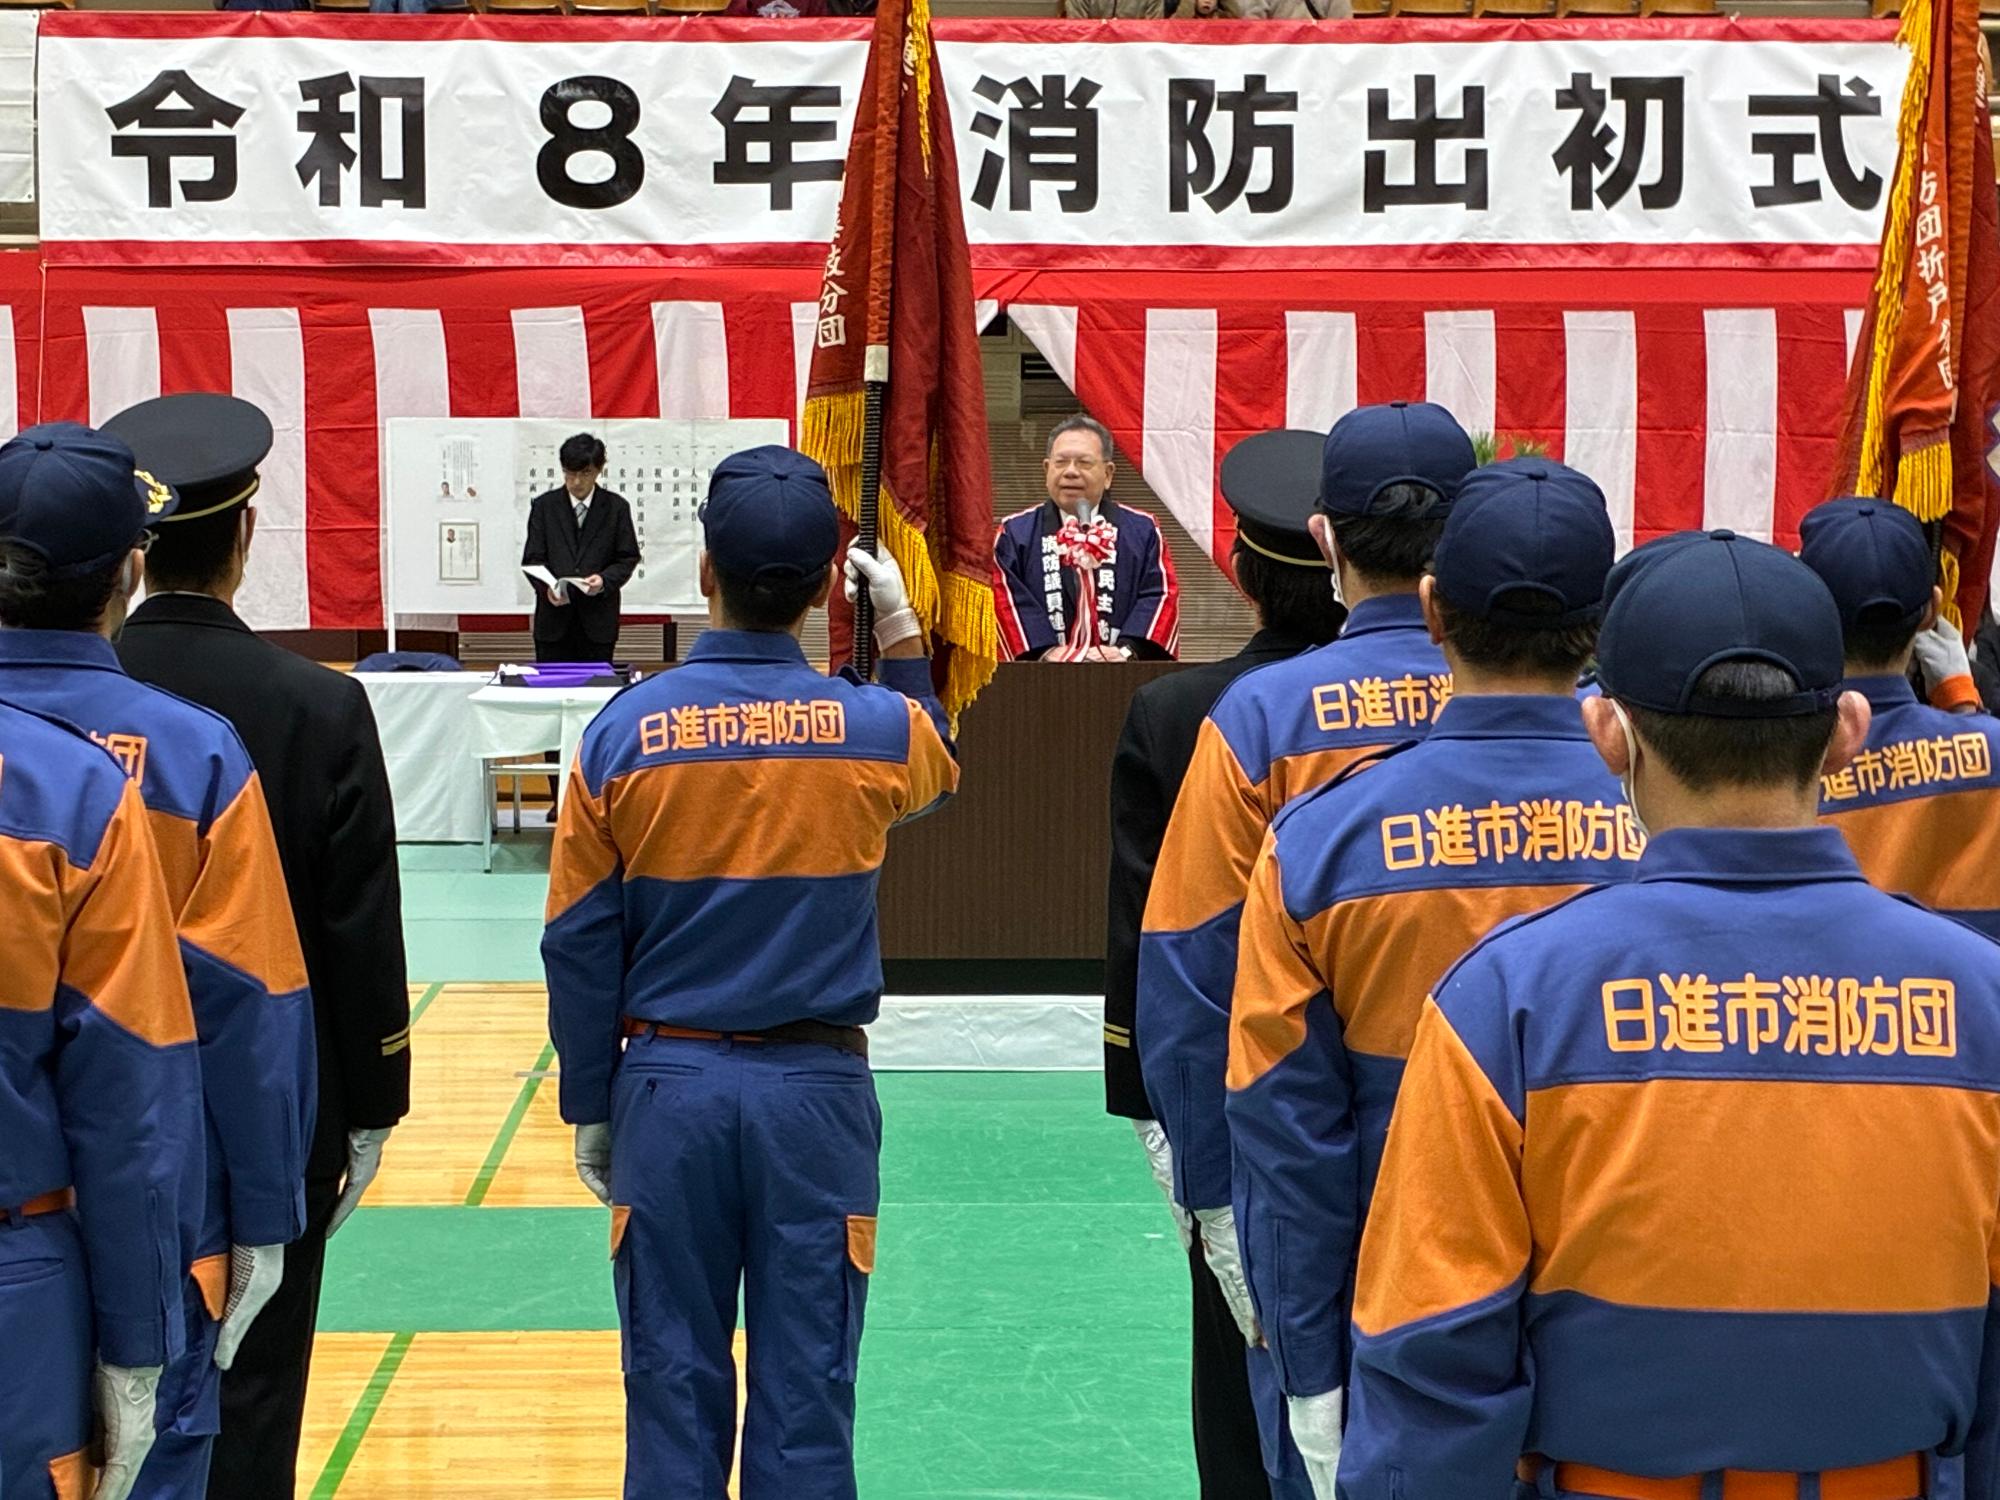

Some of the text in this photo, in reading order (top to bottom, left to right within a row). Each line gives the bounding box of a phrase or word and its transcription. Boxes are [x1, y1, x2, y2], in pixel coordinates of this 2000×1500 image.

[640, 699, 846, 755] 日進市消防団
[1602, 973, 1957, 1058] 日進市消防団
